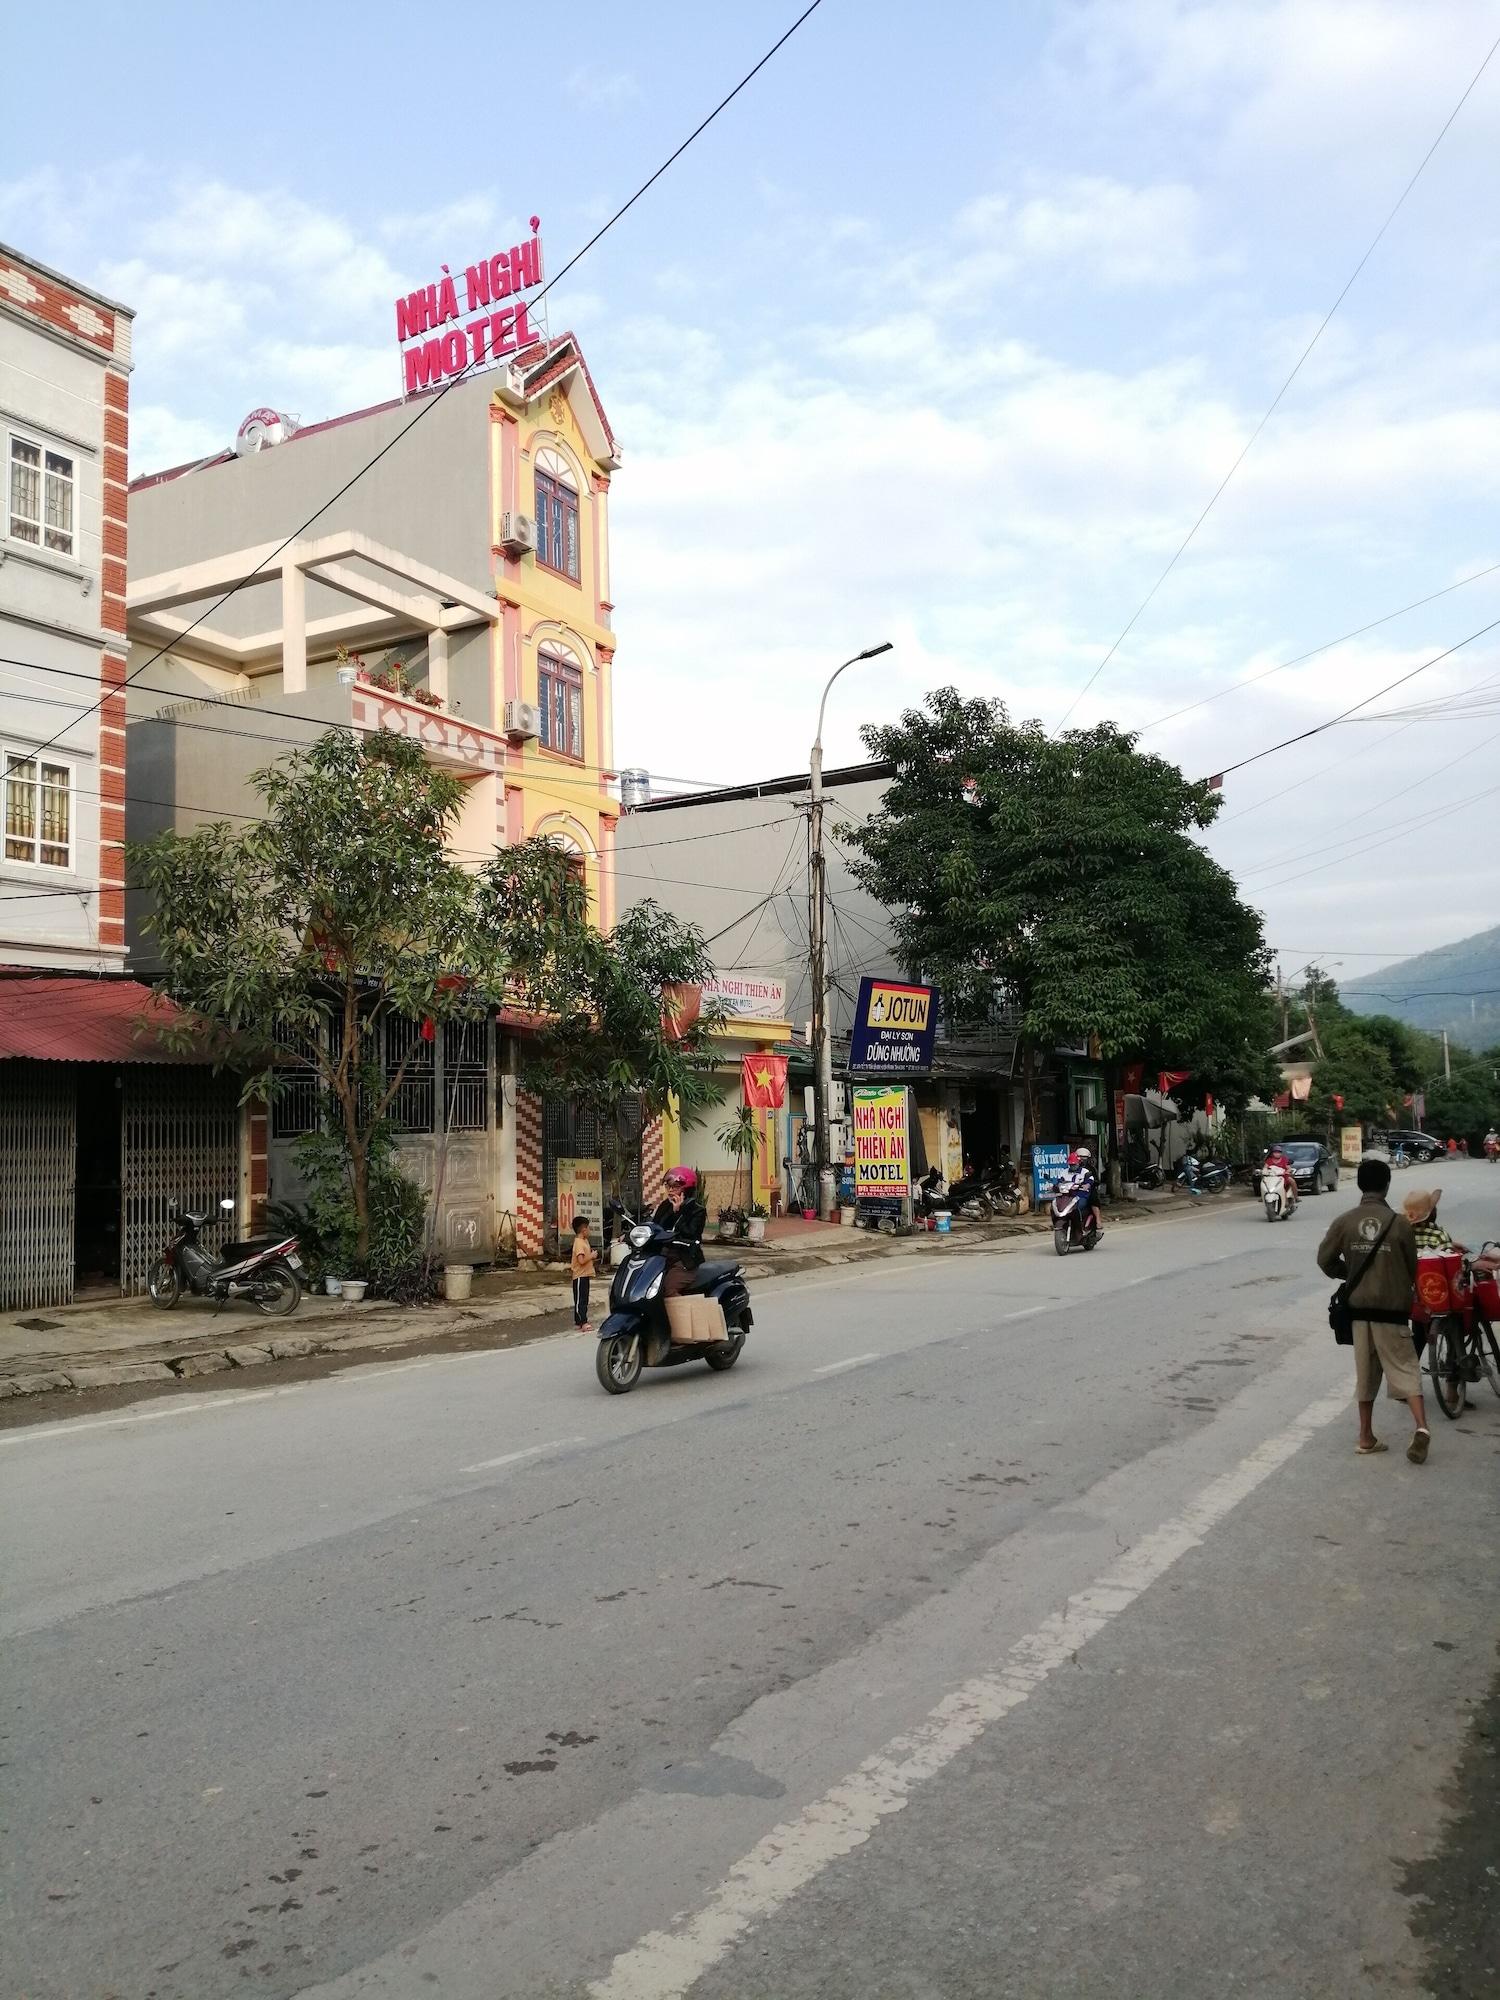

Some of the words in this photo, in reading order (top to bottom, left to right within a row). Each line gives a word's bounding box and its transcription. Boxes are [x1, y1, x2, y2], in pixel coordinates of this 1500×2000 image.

[395, 264, 460, 342] NHÀ
[465, 215, 544, 312] NGHỈ
[404, 301, 541, 396] MOTEL
[885, 996, 927, 1024] JOTUN
[880, 1030, 892, 1042] ĐẠI
[900, 1031, 914, 1041] SƠN
[867, 1042, 890, 1062] DŨNG
[856, 1100, 876, 1130] NHÀ
[879, 1097, 905, 1130] NGHỈ
[856, 1132, 887, 1159] THIÊN
[890, 1132, 905, 1159] ÂN
[859, 1164, 904, 1180] MOTEL
[560, 1185, 575, 1229] CÓ
